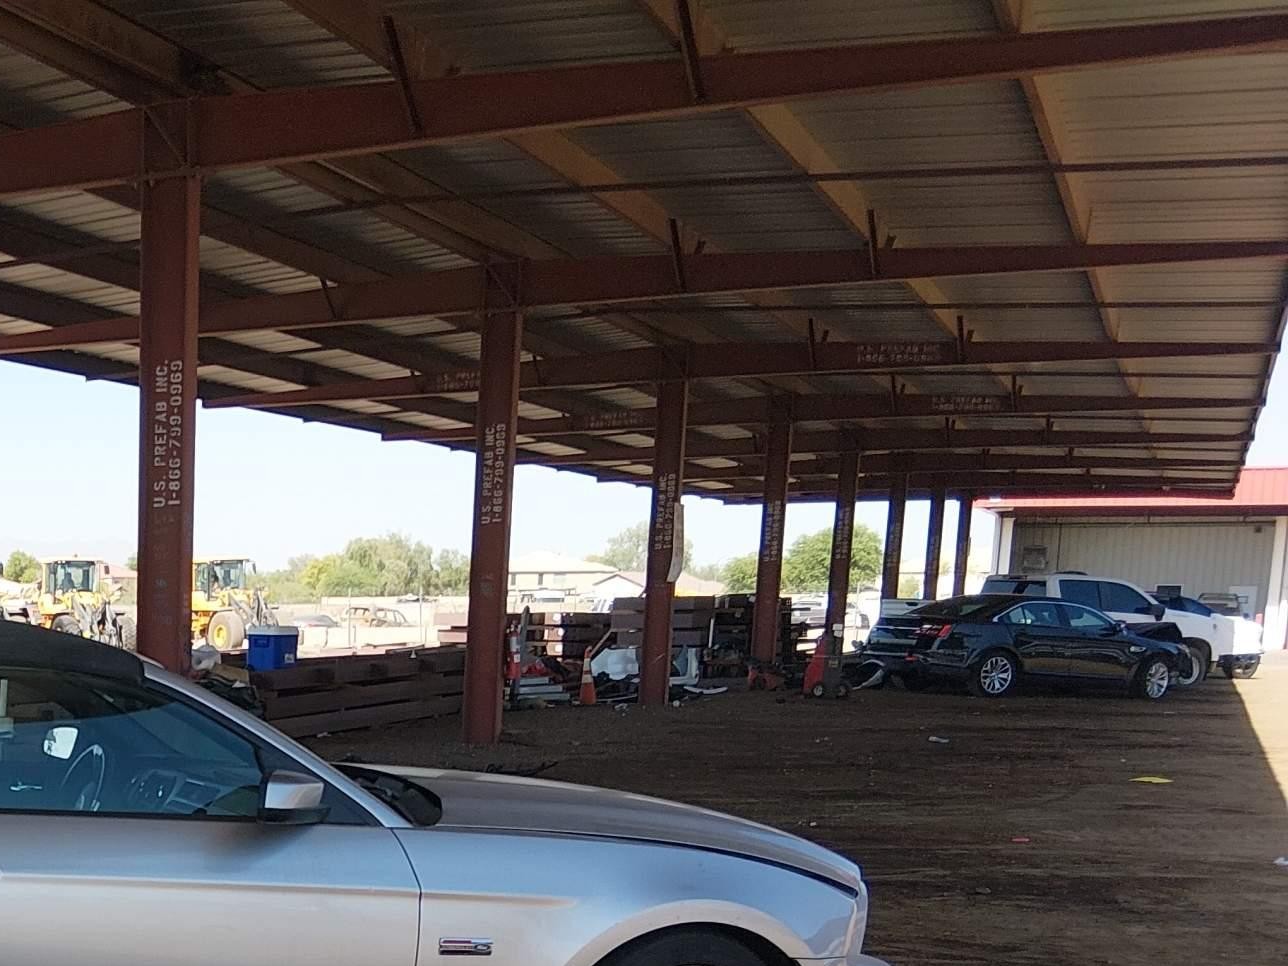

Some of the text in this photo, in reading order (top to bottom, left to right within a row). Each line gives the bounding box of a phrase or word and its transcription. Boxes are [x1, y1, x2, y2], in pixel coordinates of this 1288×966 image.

[153, 359, 169, 508] U.S. PREFAB INC.
[168, 360, 183, 506] 1-866-799-0969
[482, 451, 494, 497] PREFAB
